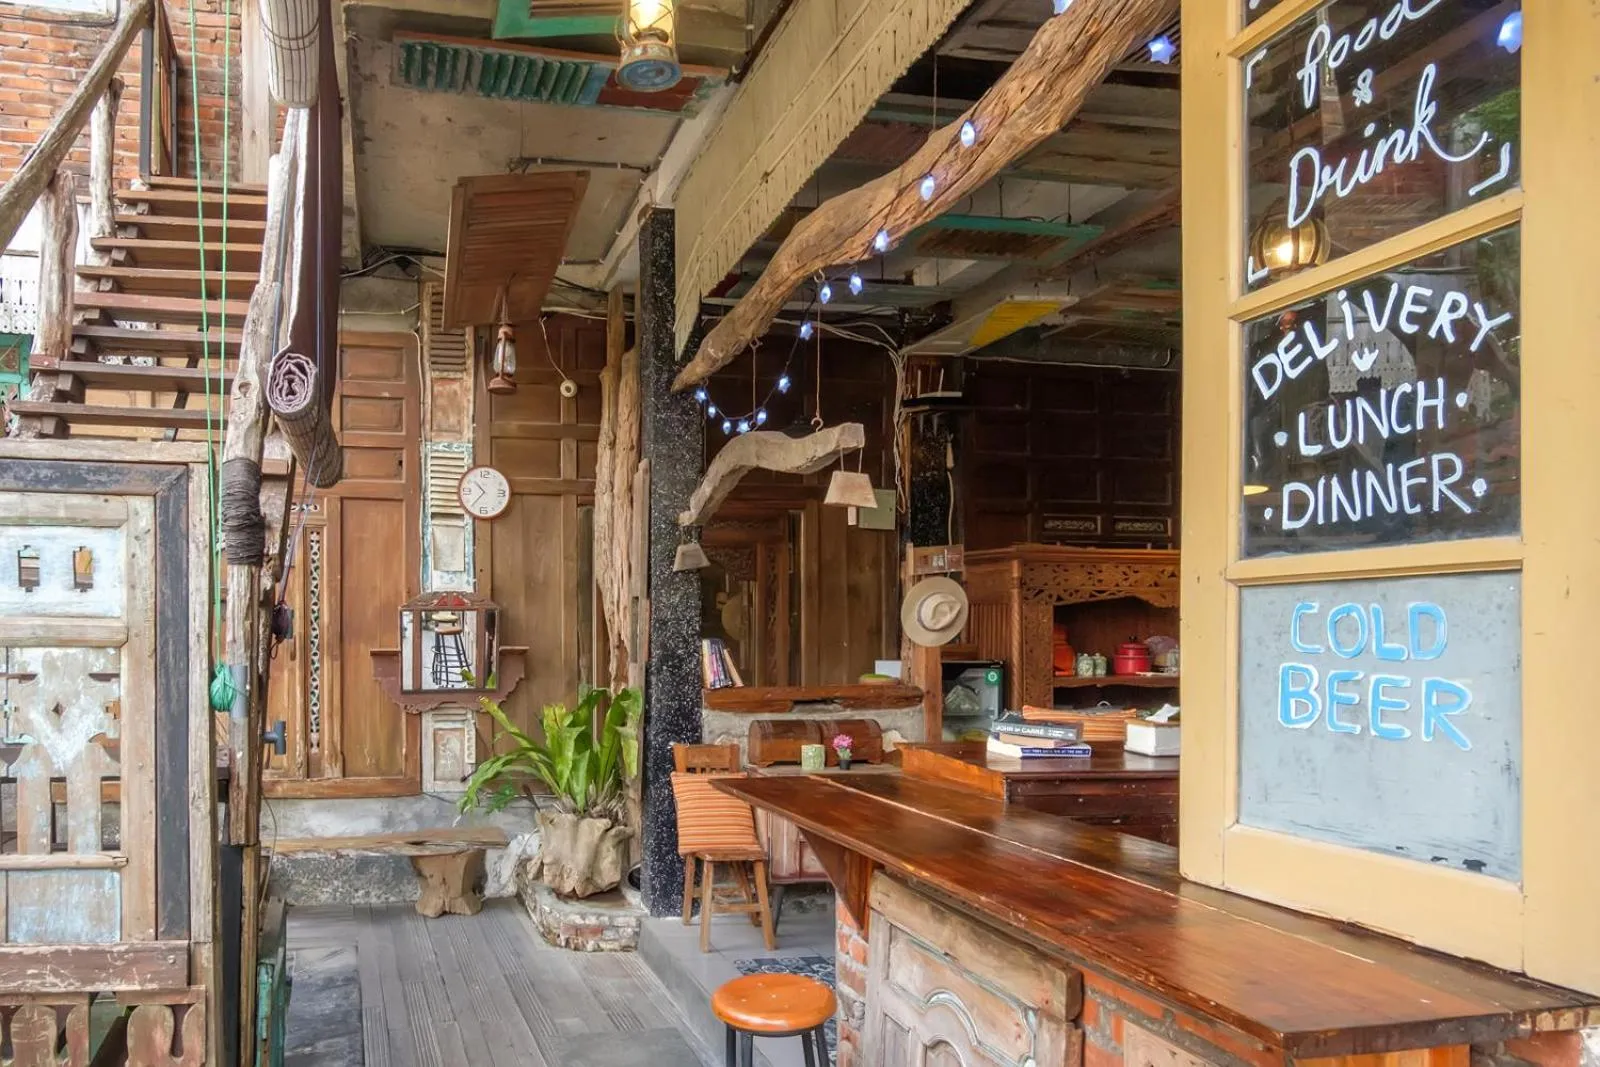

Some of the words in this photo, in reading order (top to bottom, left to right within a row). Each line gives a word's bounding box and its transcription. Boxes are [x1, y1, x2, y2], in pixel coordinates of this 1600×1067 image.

[1288, 64, 1488, 228] Drink
[1299, 378, 1444, 457] LUNCH
[480, 470, 490, 479] 12
[1282, 453, 1471, 530] DINNER
[1290, 601, 1448, 661] COLD
[1277, 662, 1473, 751] BEER
